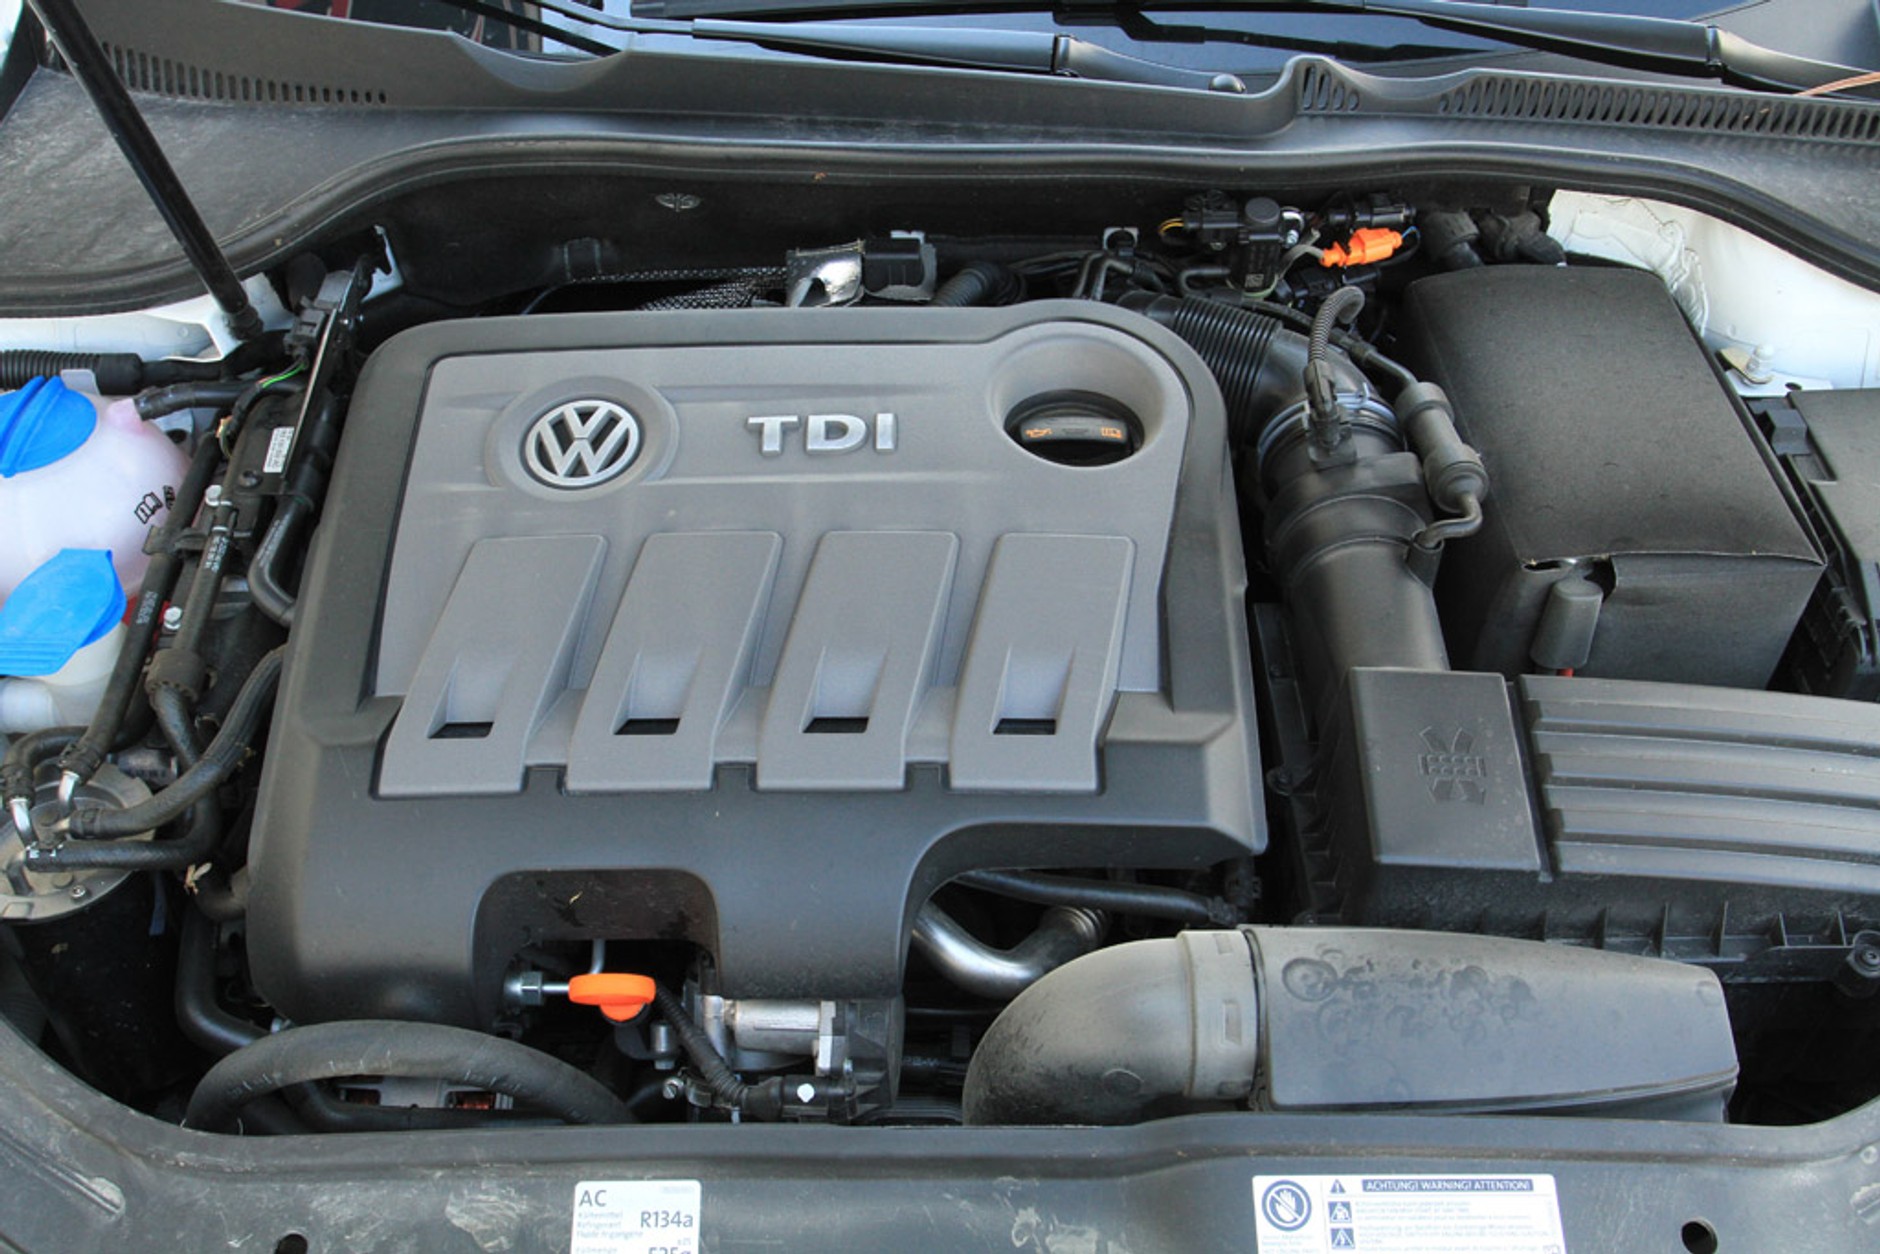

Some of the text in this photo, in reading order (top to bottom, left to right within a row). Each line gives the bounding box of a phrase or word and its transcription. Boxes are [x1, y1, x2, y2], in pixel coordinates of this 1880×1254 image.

[525, 400, 640, 487] VW
[747, 412, 898, 456] TDI
[579, 1189, 607, 1207] AC
[640, 1210, 694, 1228] R134a
